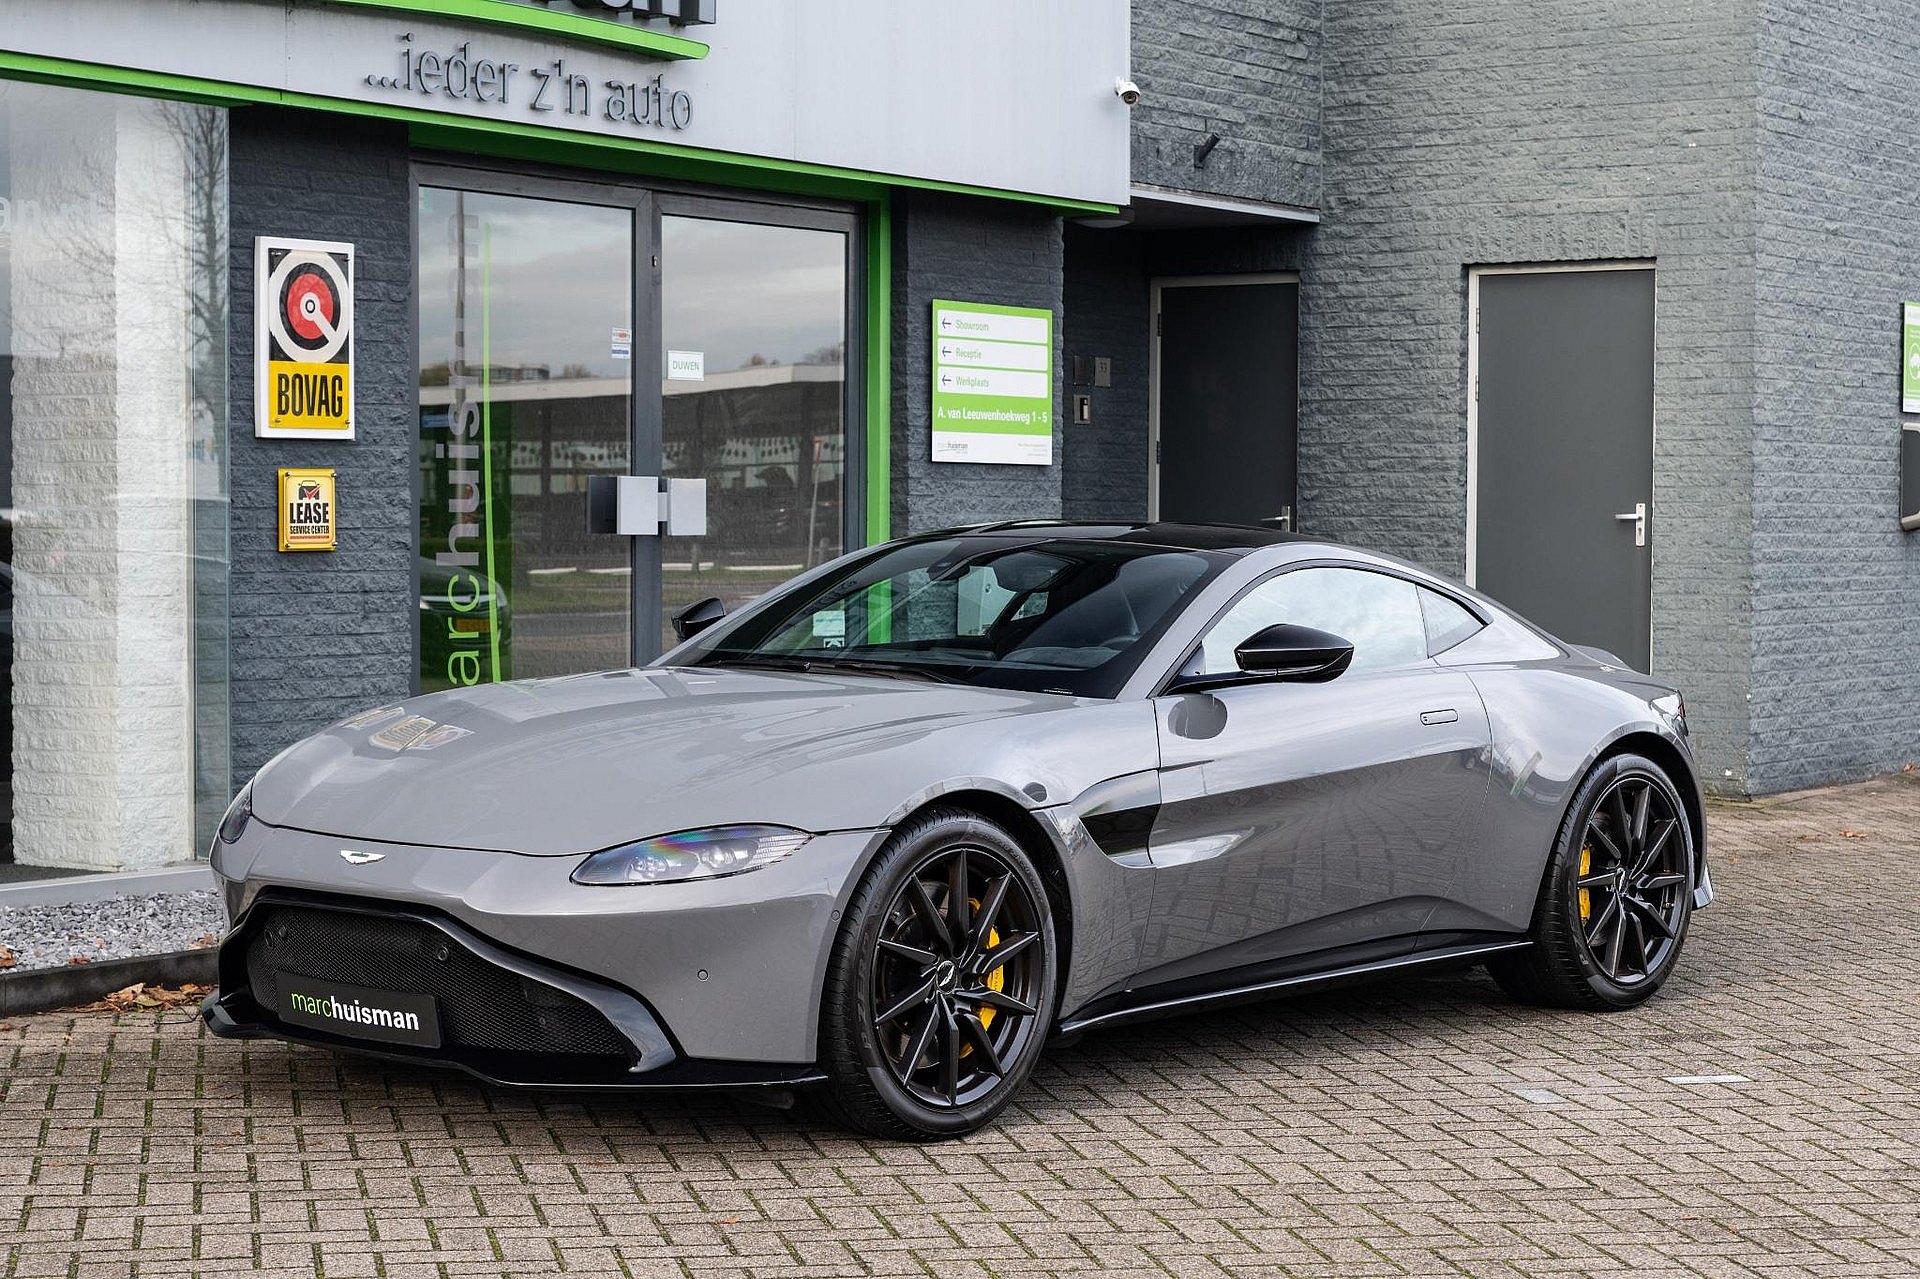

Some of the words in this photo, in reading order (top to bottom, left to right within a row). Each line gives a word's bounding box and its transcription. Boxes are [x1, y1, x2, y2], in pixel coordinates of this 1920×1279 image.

[531, 59, 592, 117] z'n
[604, 73, 695, 131] auto
[955, 319, 989, 332] Showroom
[955, 347, 982, 360] Receptie
[672, 360, 700, 371] DUWEN
[955, 376, 990, 388] Werkplaats
[277, 373, 343, 418] BOVAG
[937, 406, 945, 418] A.
[947, 409, 961, 420] van
[962, 407, 1031, 425] Leeuwenhoekweg
[1032, 411, 1037, 423] 1
[1043, 411, 1048, 424] 5
[435, 214, 480, 686] archuisman
[289, 503, 330, 524] LEASE
[289, 525, 310, 535] SERVICE
[311, 525, 330, 535] CENTER
[290, 992, 420, 1031] marchuisman
